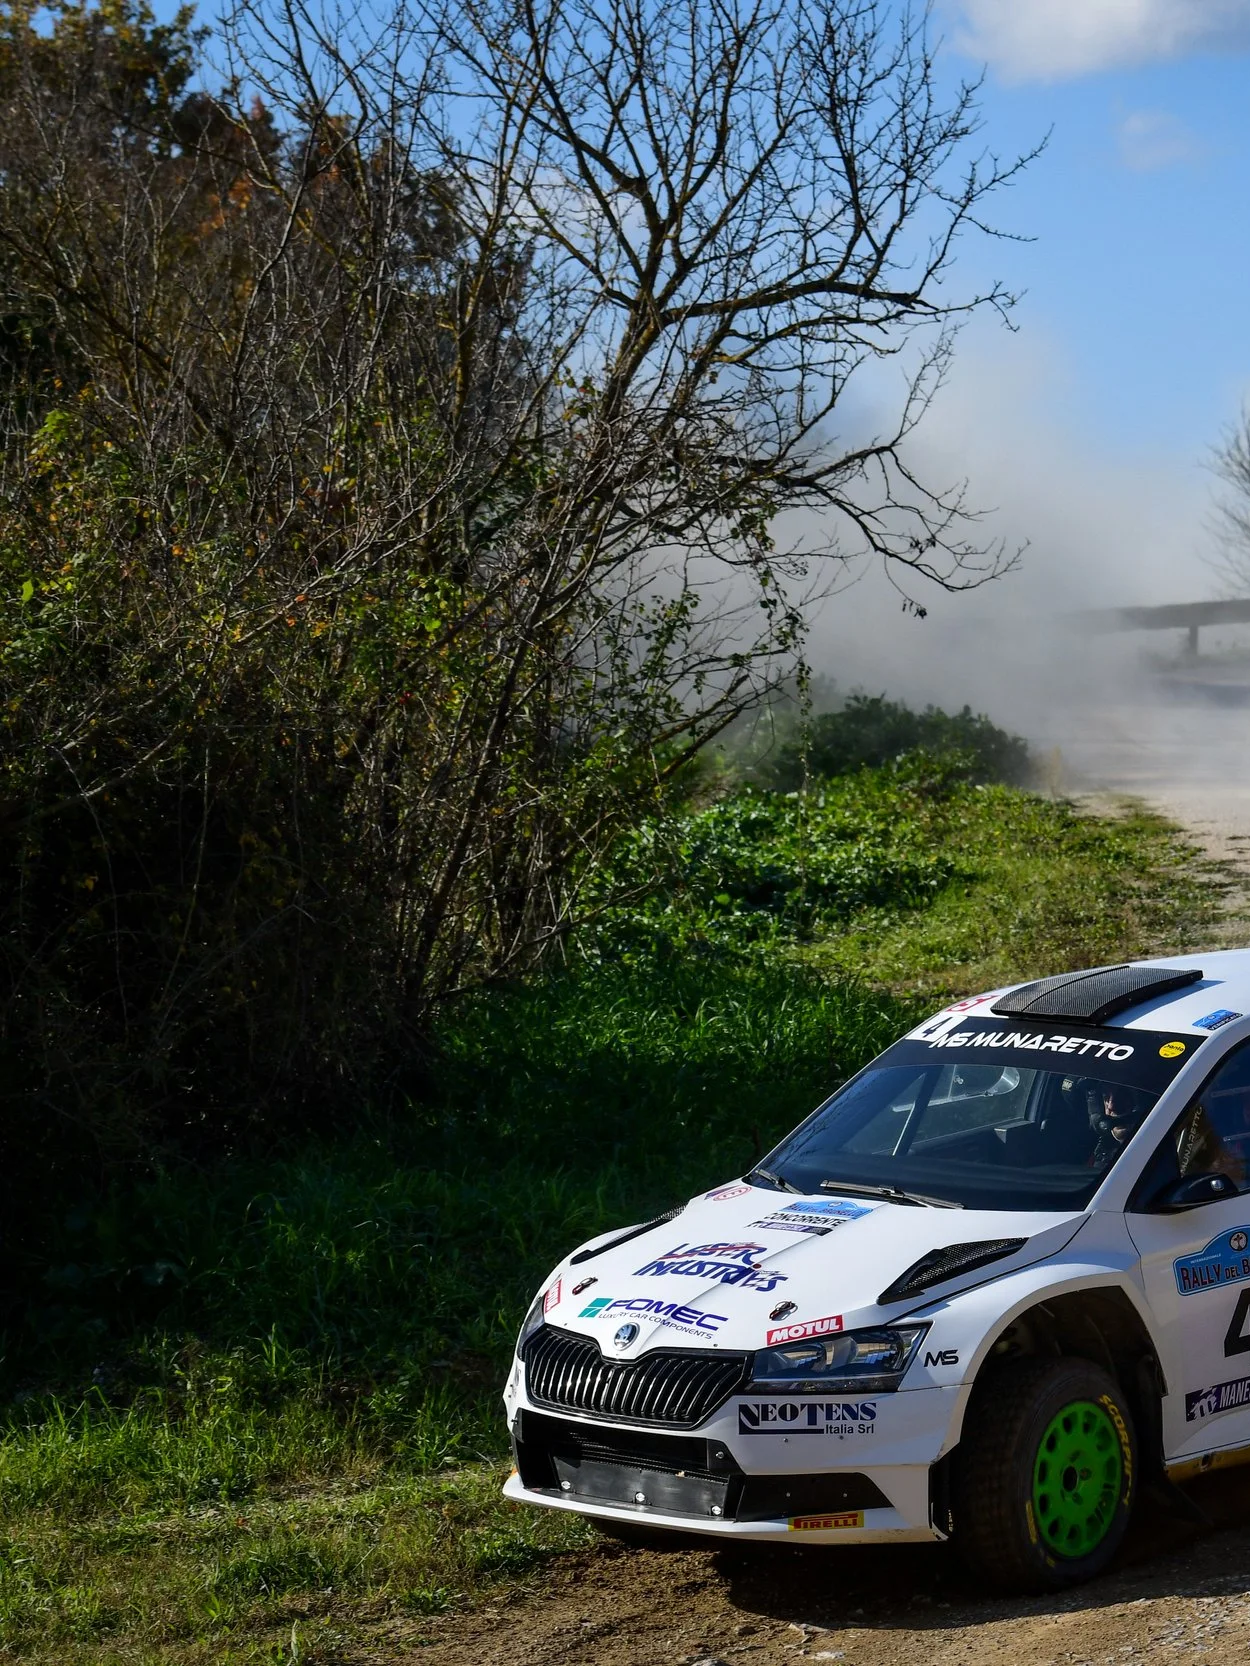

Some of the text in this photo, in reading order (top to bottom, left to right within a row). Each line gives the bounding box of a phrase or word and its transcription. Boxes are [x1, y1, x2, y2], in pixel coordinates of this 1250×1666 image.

[929, 1031, 1135, 1061] MS MUNARETTO
[764, 1212, 848, 1228] CONCORRENTE
[632, 1260, 789, 1292] INDUSTRIES
[1180, 1263, 1222, 1291] RALLY
[1225, 1266, 1241, 1280] DEL
[598, 1312, 714, 1340] LUXURY CAR COMPONENTS
[606, 1298, 729, 1331] FOMEC
[770, 1318, 841, 1344] MOTUL
[924, 1350, 959, 1367] MS
[739, 1403, 877, 1429] NEOTENS
[825, 1424, 875, 1434] Italia Srl
[793, 1512, 859, 1530] PIRELLI
